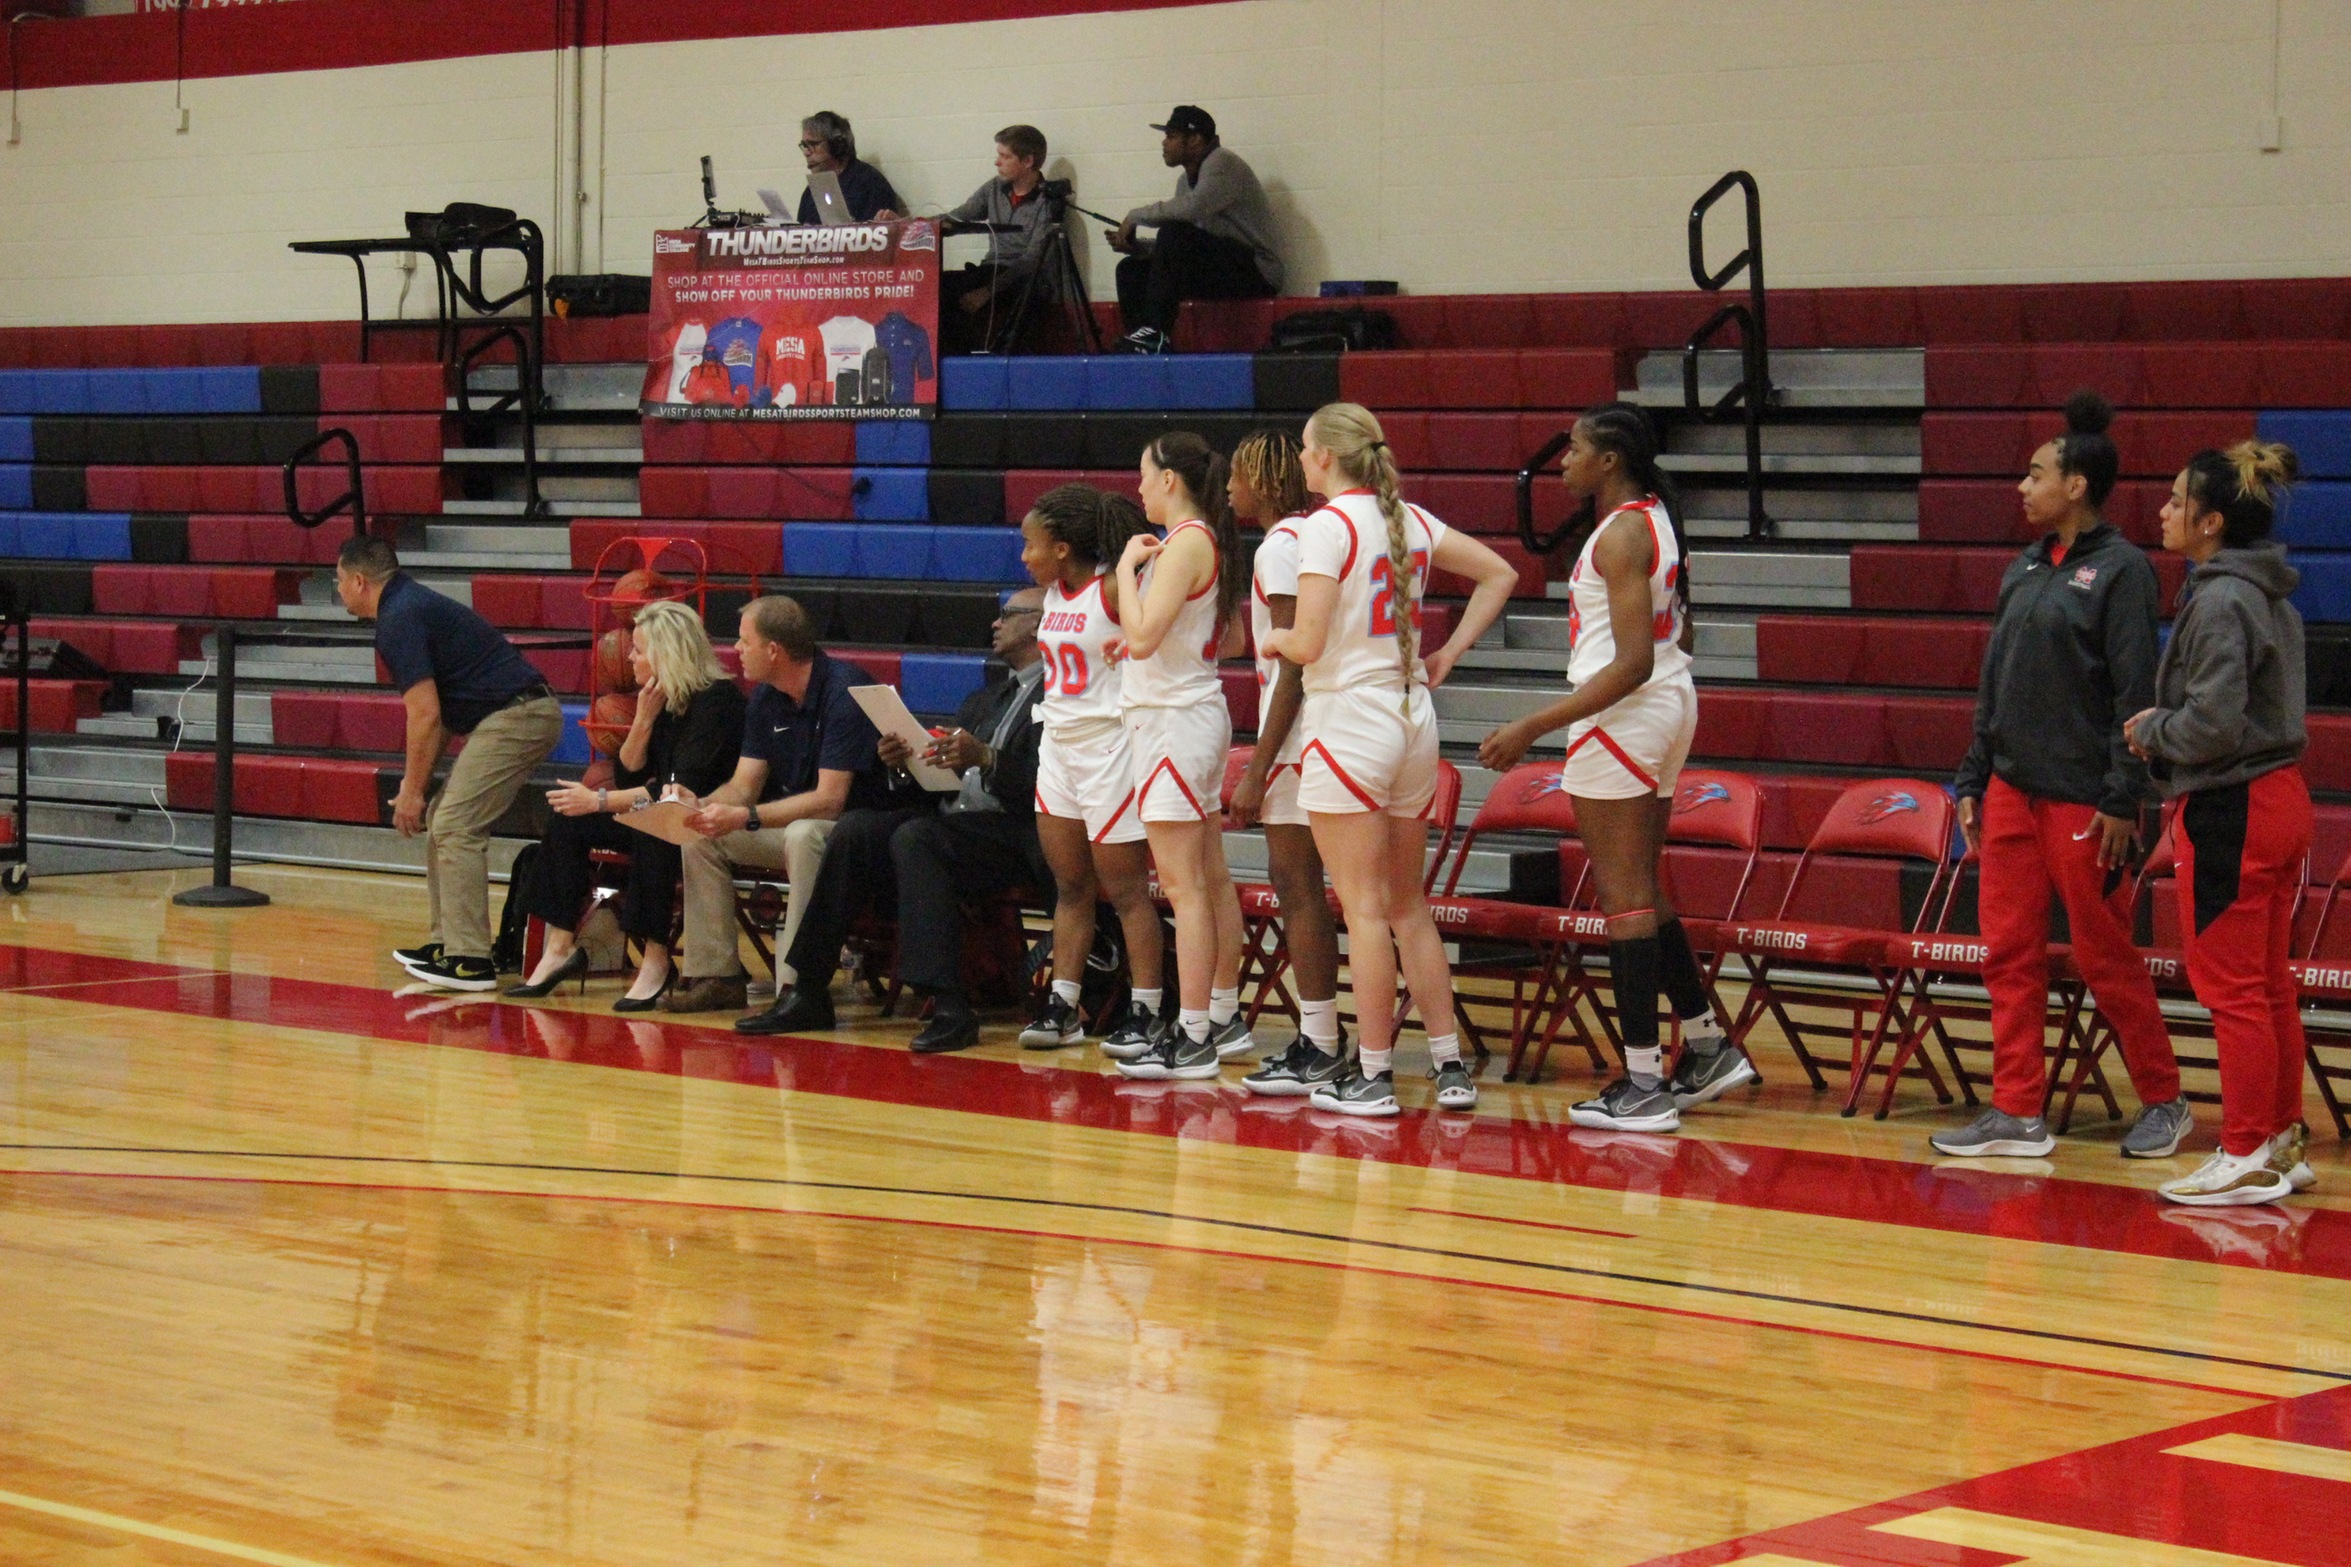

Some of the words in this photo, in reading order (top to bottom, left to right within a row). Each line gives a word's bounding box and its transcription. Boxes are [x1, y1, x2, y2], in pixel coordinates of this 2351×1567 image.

[707, 226, 888, 256] THUNDERBIRDS
[668, 275, 698, 288] SHOP
[701, 275, 714, 287] AT
[718, 274, 742, 286] THE
[746, 273, 799, 286] OFFICIAL
[803, 271, 848, 285] ONLINE
[852, 270, 895, 284] STORE
[899, 269, 925, 283] AND
[675, 290, 708, 303] SHOW
[711, 289, 736, 302] OFF
[740, 288, 771, 301] YOUR
[776, 286, 870, 300] THUNDERBIRDS
[874, 285, 914, 299] PRIDE!
[776, 336, 806, 355] MESA
[659, 406, 688, 417] VISIT
[691, 407, 701, 418] US
[703, 408, 736, 418] ONLINE
[739, 408, 749, 418] AT
[752, 408, 920, 419] MESATBIRDSSPORTSTEAMSHOP.COM
[1737, 927, 1808, 950] T-BIRDS
